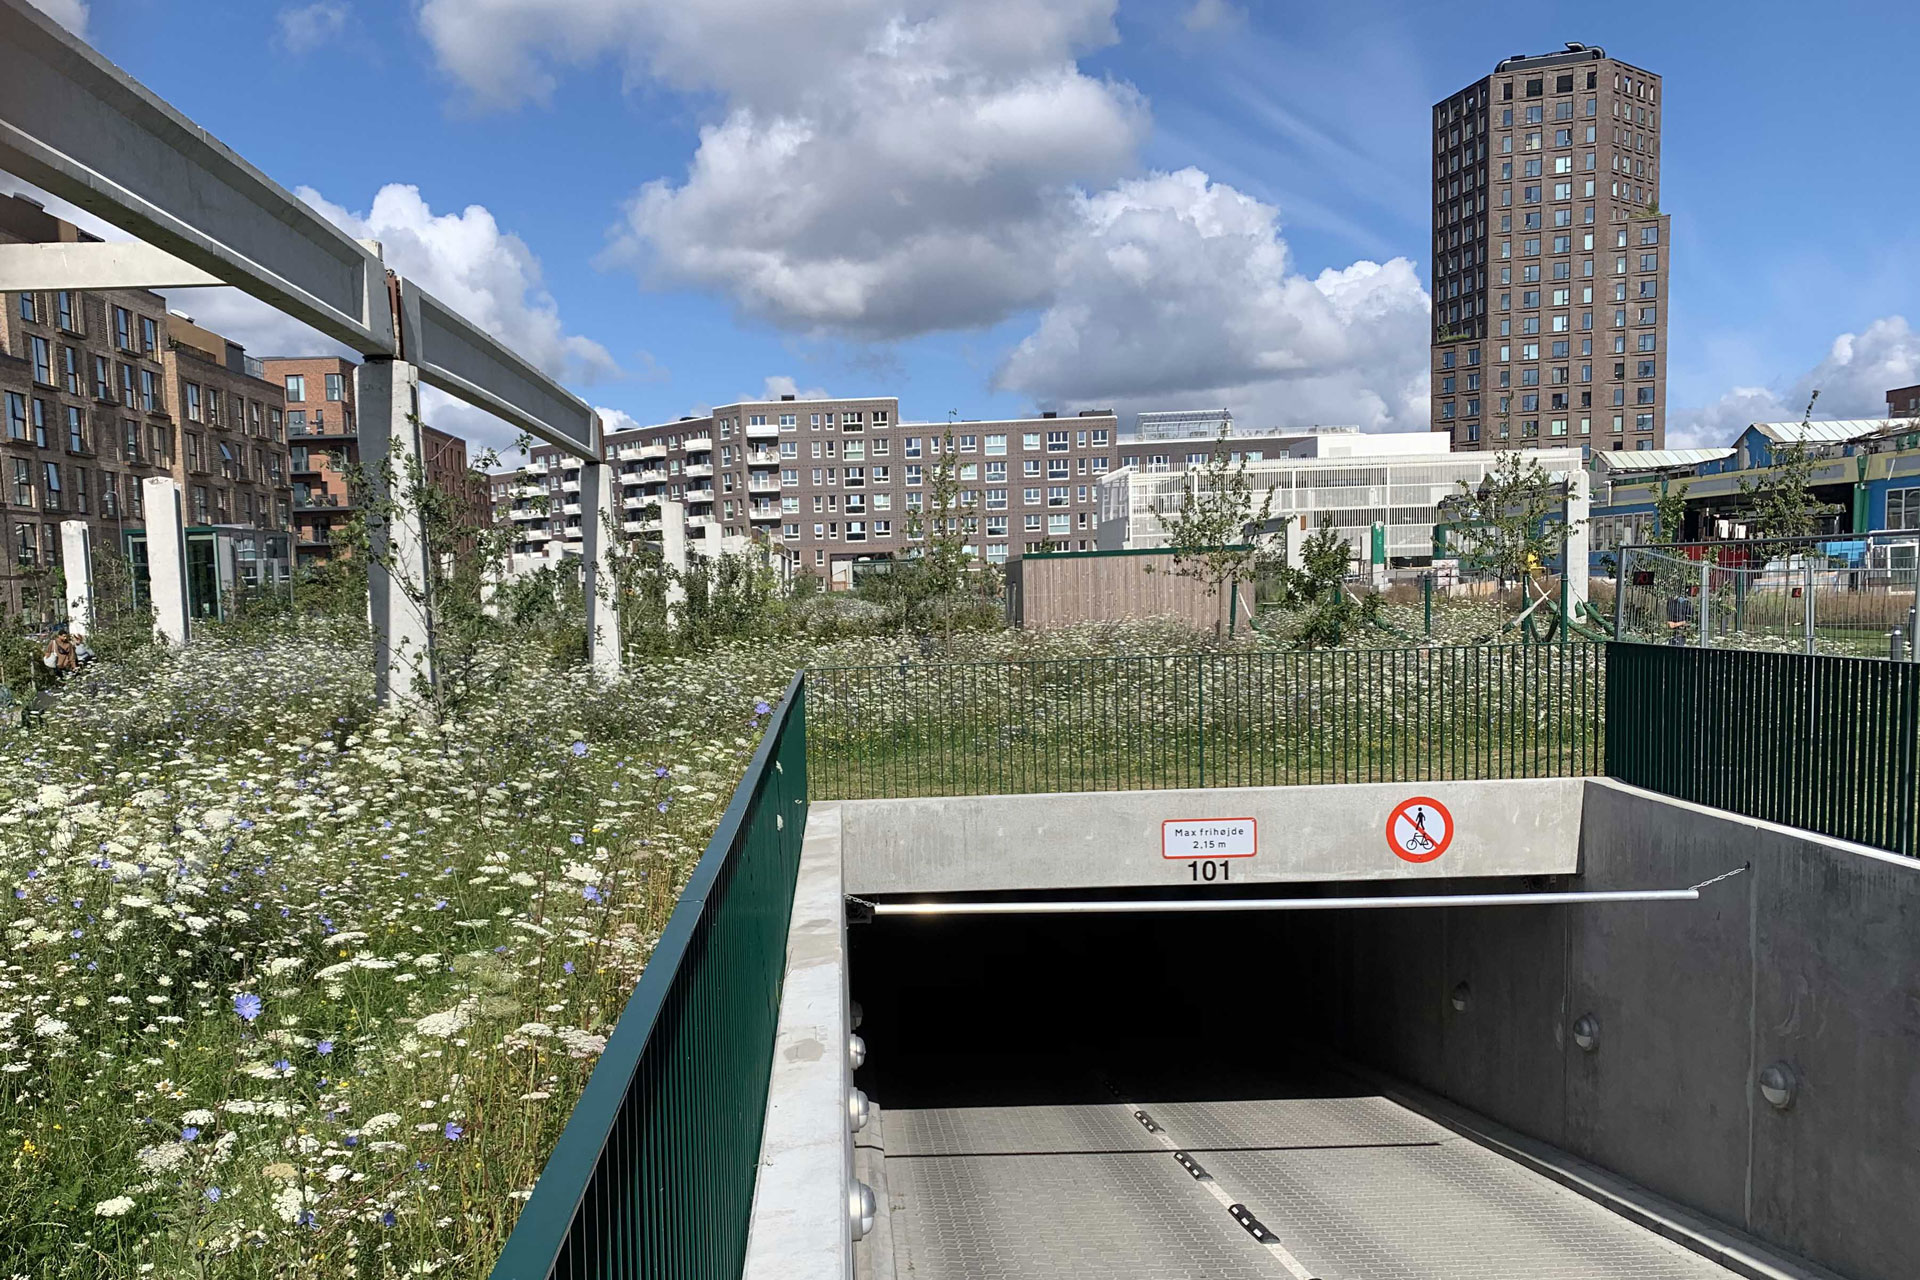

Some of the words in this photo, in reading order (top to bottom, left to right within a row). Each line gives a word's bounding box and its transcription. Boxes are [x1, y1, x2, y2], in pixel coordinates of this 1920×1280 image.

[1175, 829, 1197, 837] Max
[1199, 827, 1244, 837] frihøjde
[1187, 860, 1229, 881] 101
